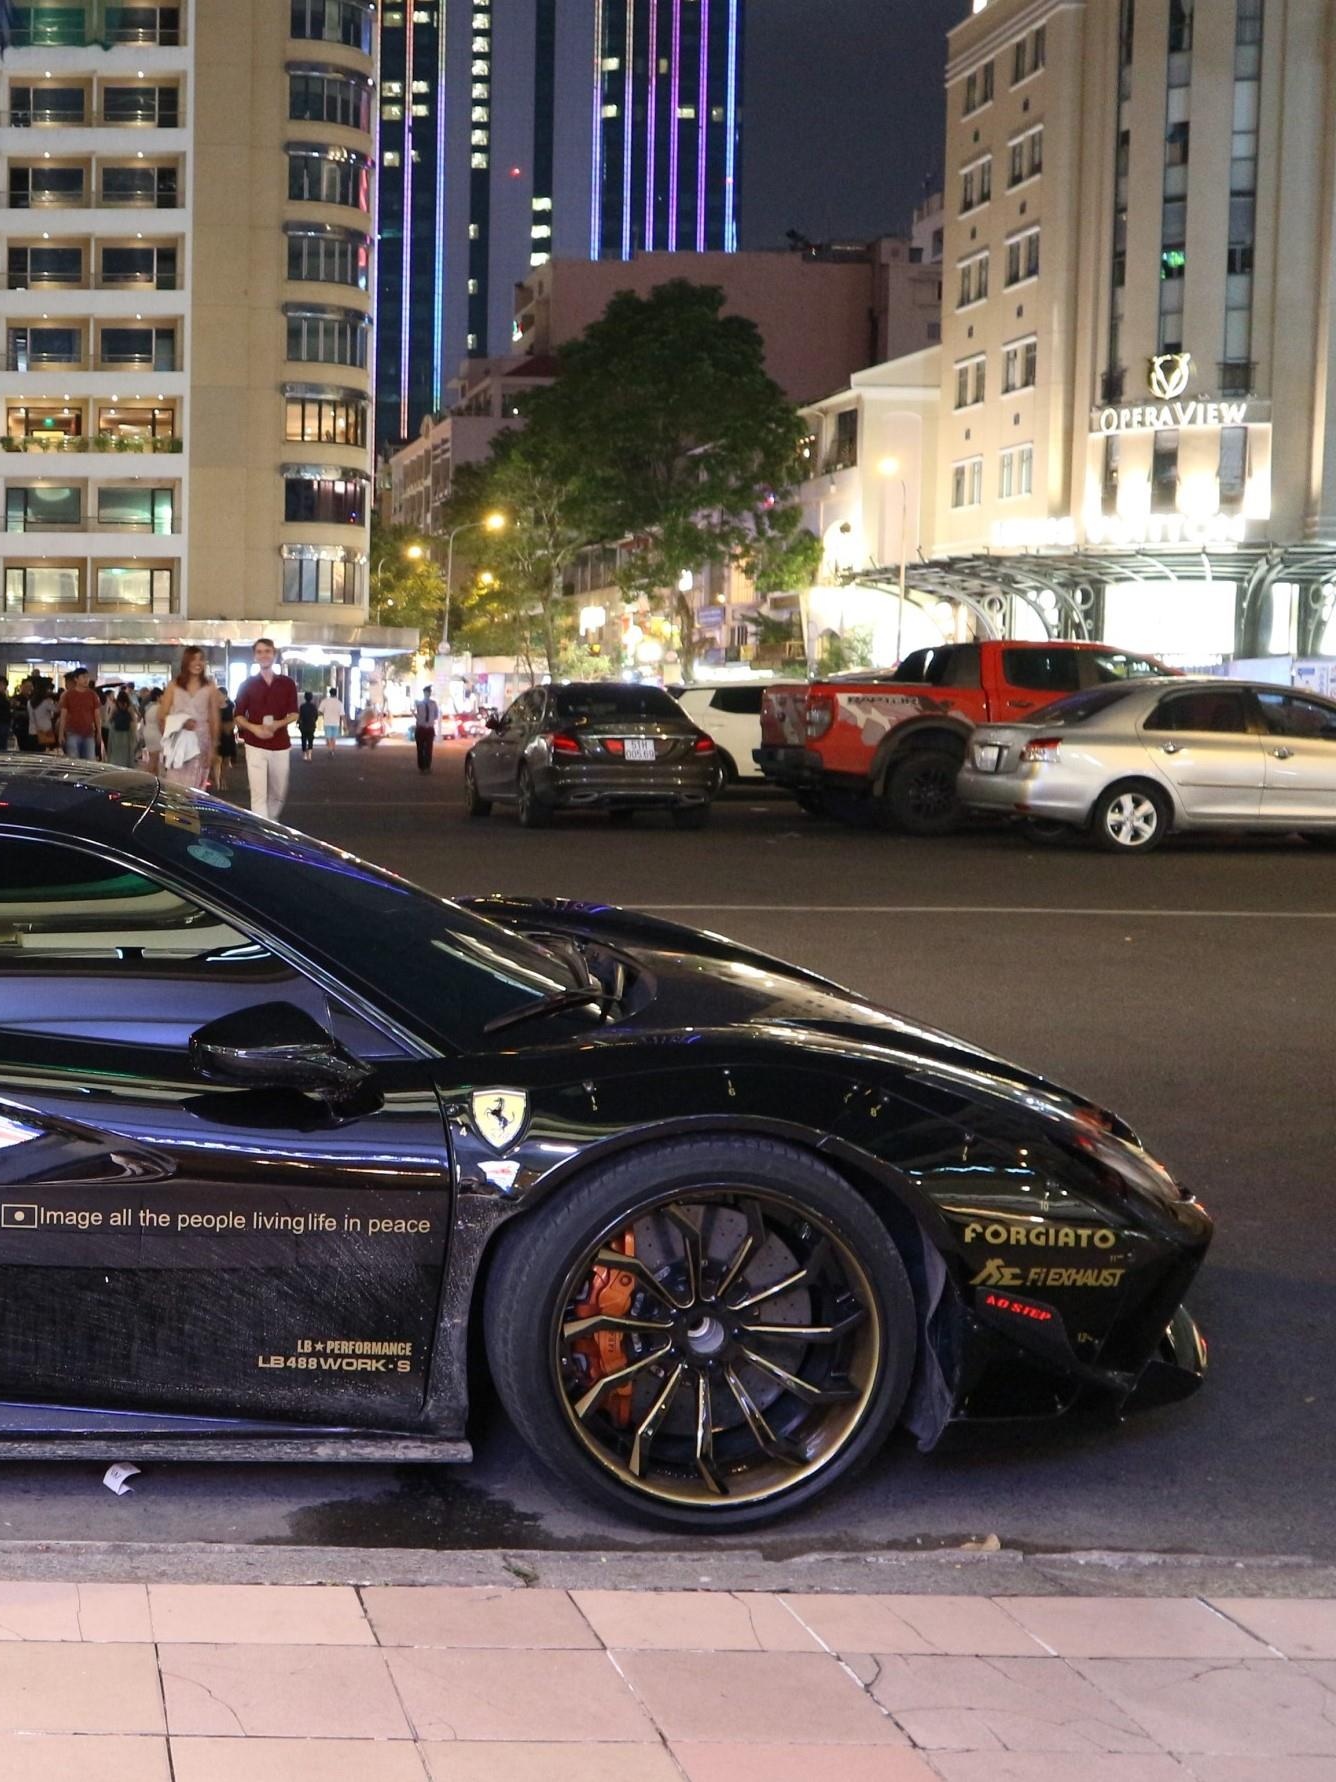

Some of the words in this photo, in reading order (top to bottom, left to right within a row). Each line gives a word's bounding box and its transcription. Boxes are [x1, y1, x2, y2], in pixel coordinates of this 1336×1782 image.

[40, 1206, 102, 1229] Image
[110, 1208, 132, 1227] all
[139, 1209, 170, 1227] the
[177, 1211, 246, 1232] people
[344, 1214, 361, 1232] in
[368, 1218, 431, 1236] peace
[965, 1223, 1116, 1249] FORGIATO
[1047, 1268, 1126, 1287] EXHAUST
[326, 1340, 413, 1356] PERFORMANCE
